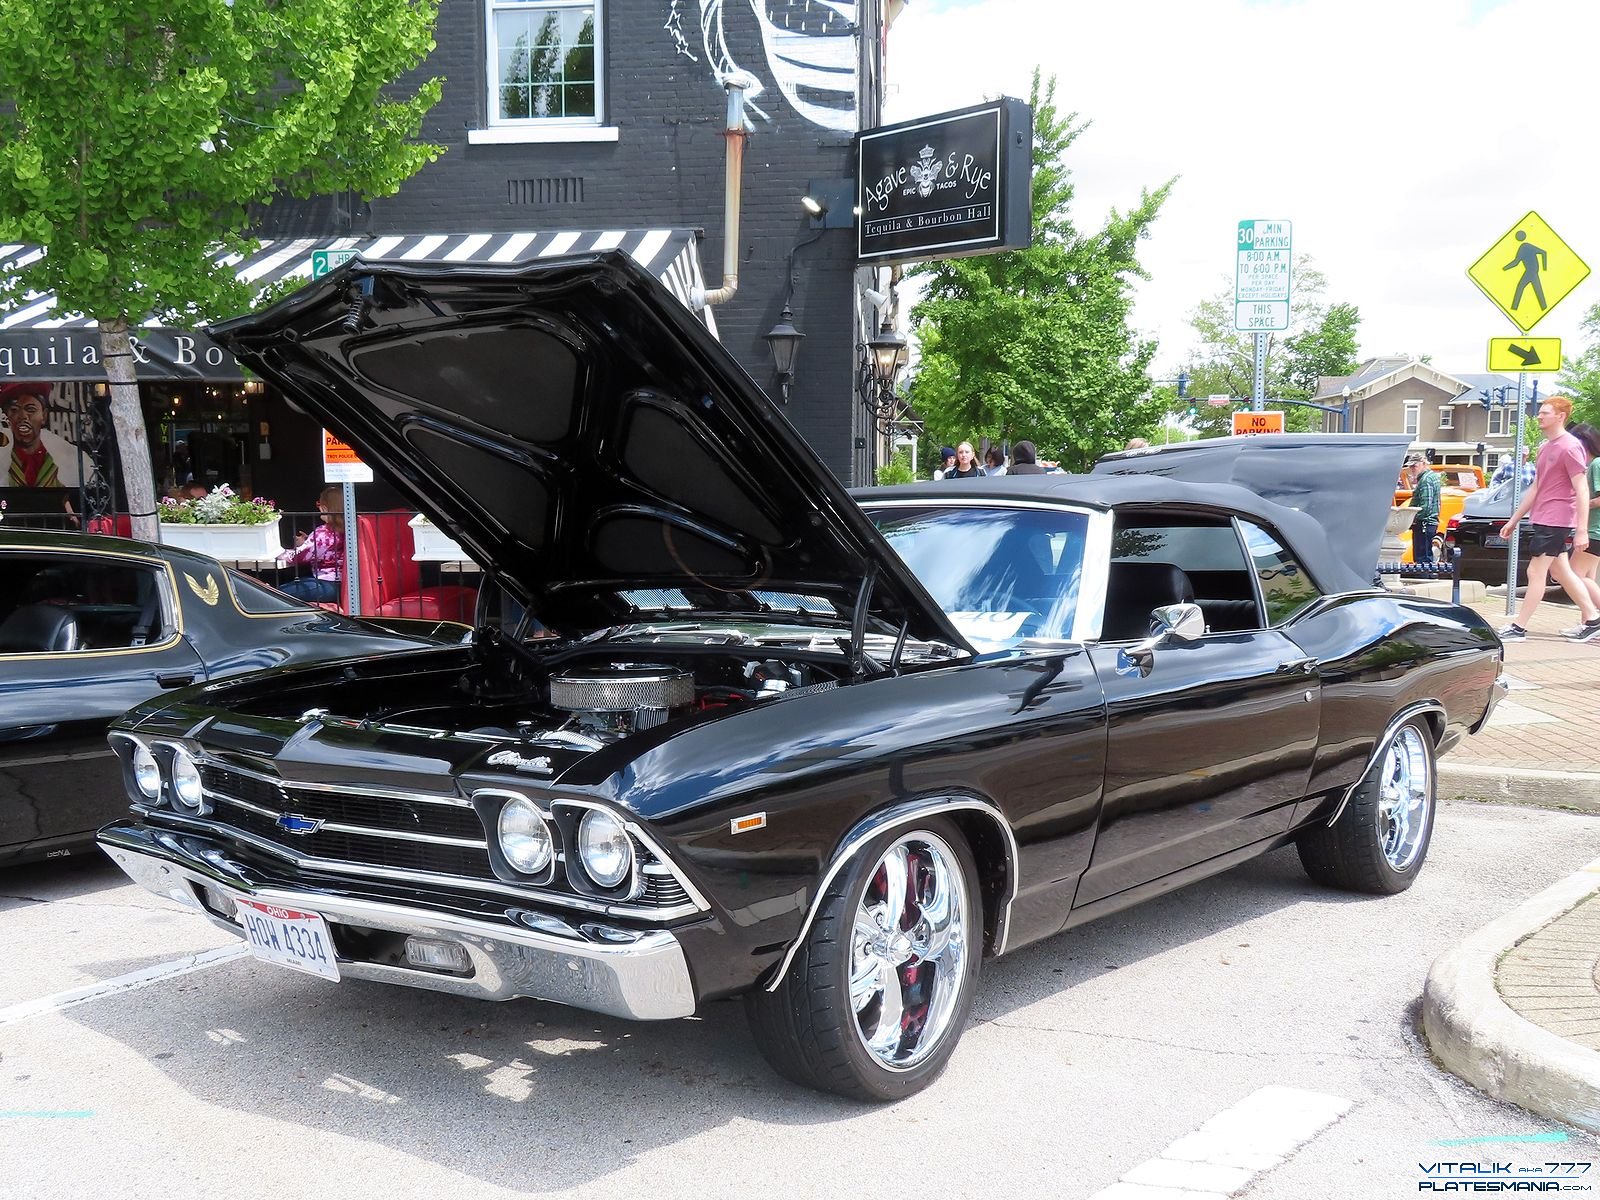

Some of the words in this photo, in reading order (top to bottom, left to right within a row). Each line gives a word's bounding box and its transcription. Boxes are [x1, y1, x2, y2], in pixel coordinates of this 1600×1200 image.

[865, 166, 907, 211] Agave
[945, 152, 958, 178] &
[960, 153, 991, 199] Rye
[903, 187, 916, 196] EPIC
[936, 180, 957, 190] TACOS
[865, 220, 901, 235] Tequila
[905, 218, 913, 228] &
[918, 212, 962, 227] Bourbon
[967, 205, 991, 219] Hall
[1238, 228, 1254, 244] 30
[1266, 224, 1282, 234] MIN
[1255, 236, 1289, 247] PARKING
[315, 256, 328, 276] 2
[1240, 264, 1249, 273] TO
[1253, 304, 1272, 314] THIS
[1249, 317, 1275, 327] SPACE
[0, 337, 99, 375] quila
[174, 336, 243, 366] Bo
[1252, 418, 1266, 427] NO
[266, 906, 289, 919] OHIO
[283, 923, 327, 964] 4334
